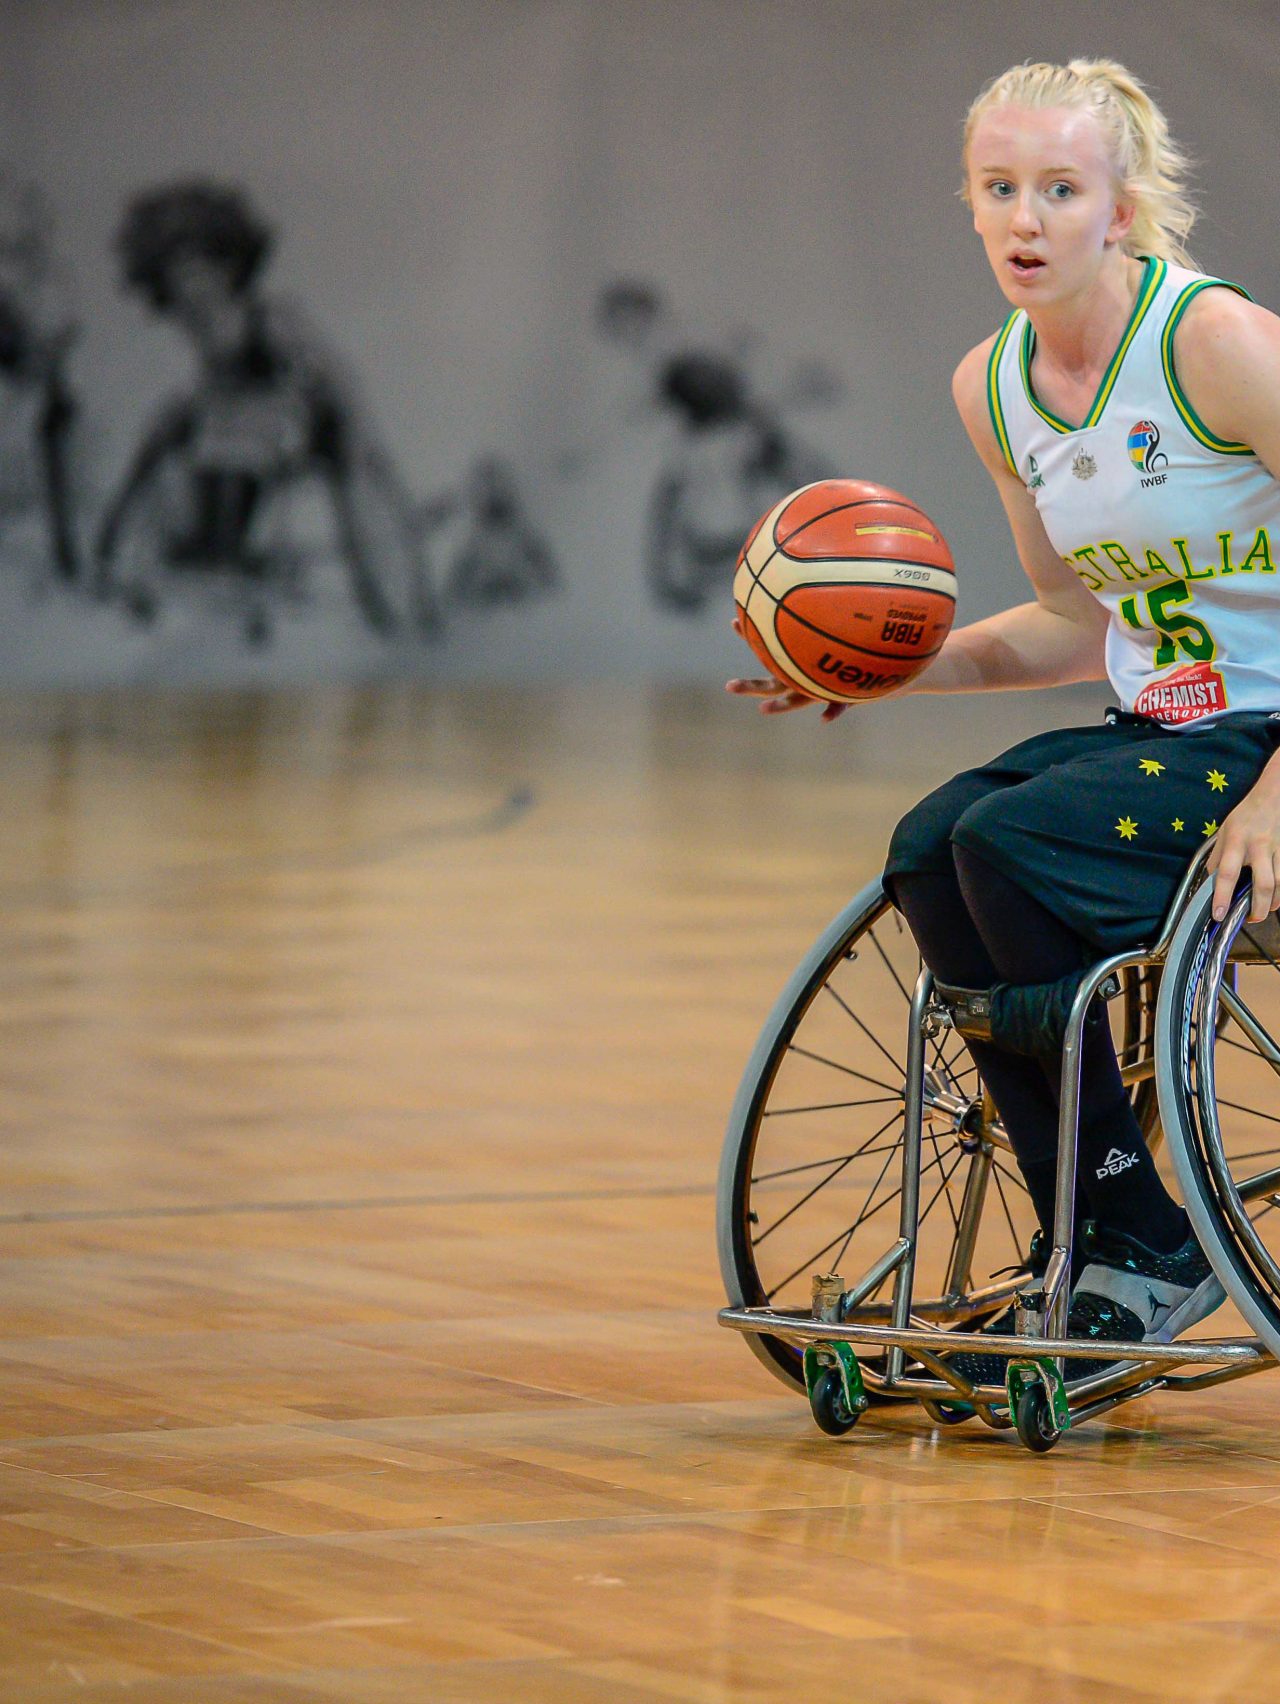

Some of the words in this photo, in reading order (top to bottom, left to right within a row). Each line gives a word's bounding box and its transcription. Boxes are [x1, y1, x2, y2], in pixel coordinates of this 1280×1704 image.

[1140, 474, 1168, 488] IWBF
[881, 621, 925, 646] FIBA
[1119, 578, 1217, 670] 15
[817, 652, 906, 691] olten
[1137, 681, 1217, 714] CHEMIST
[1096, 1151, 1140, 1180] PEAK
